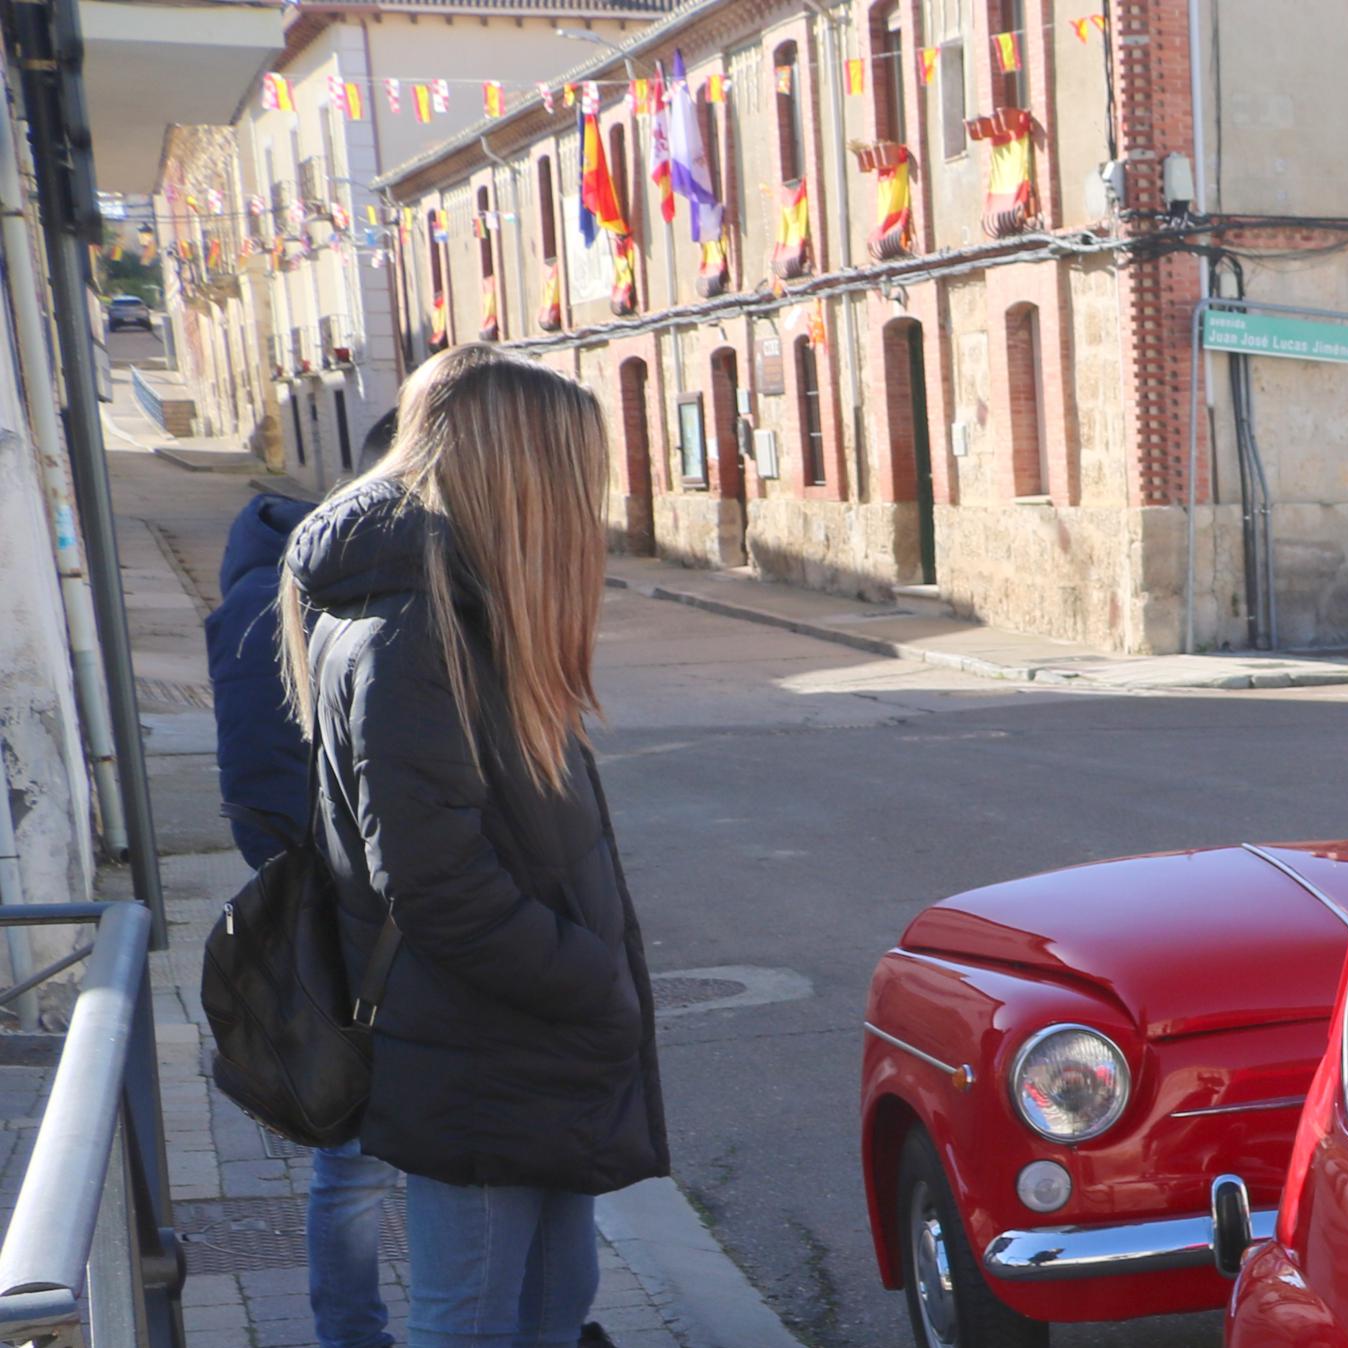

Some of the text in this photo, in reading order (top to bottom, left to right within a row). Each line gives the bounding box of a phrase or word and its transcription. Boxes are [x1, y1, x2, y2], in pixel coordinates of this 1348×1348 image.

[1209, 316, 1247, 330] avenida
[1208, 330, 1238, 344] Juan
[1240, 332, 1269, 348] José
[1272, 336, 1309, 352] Lucas
